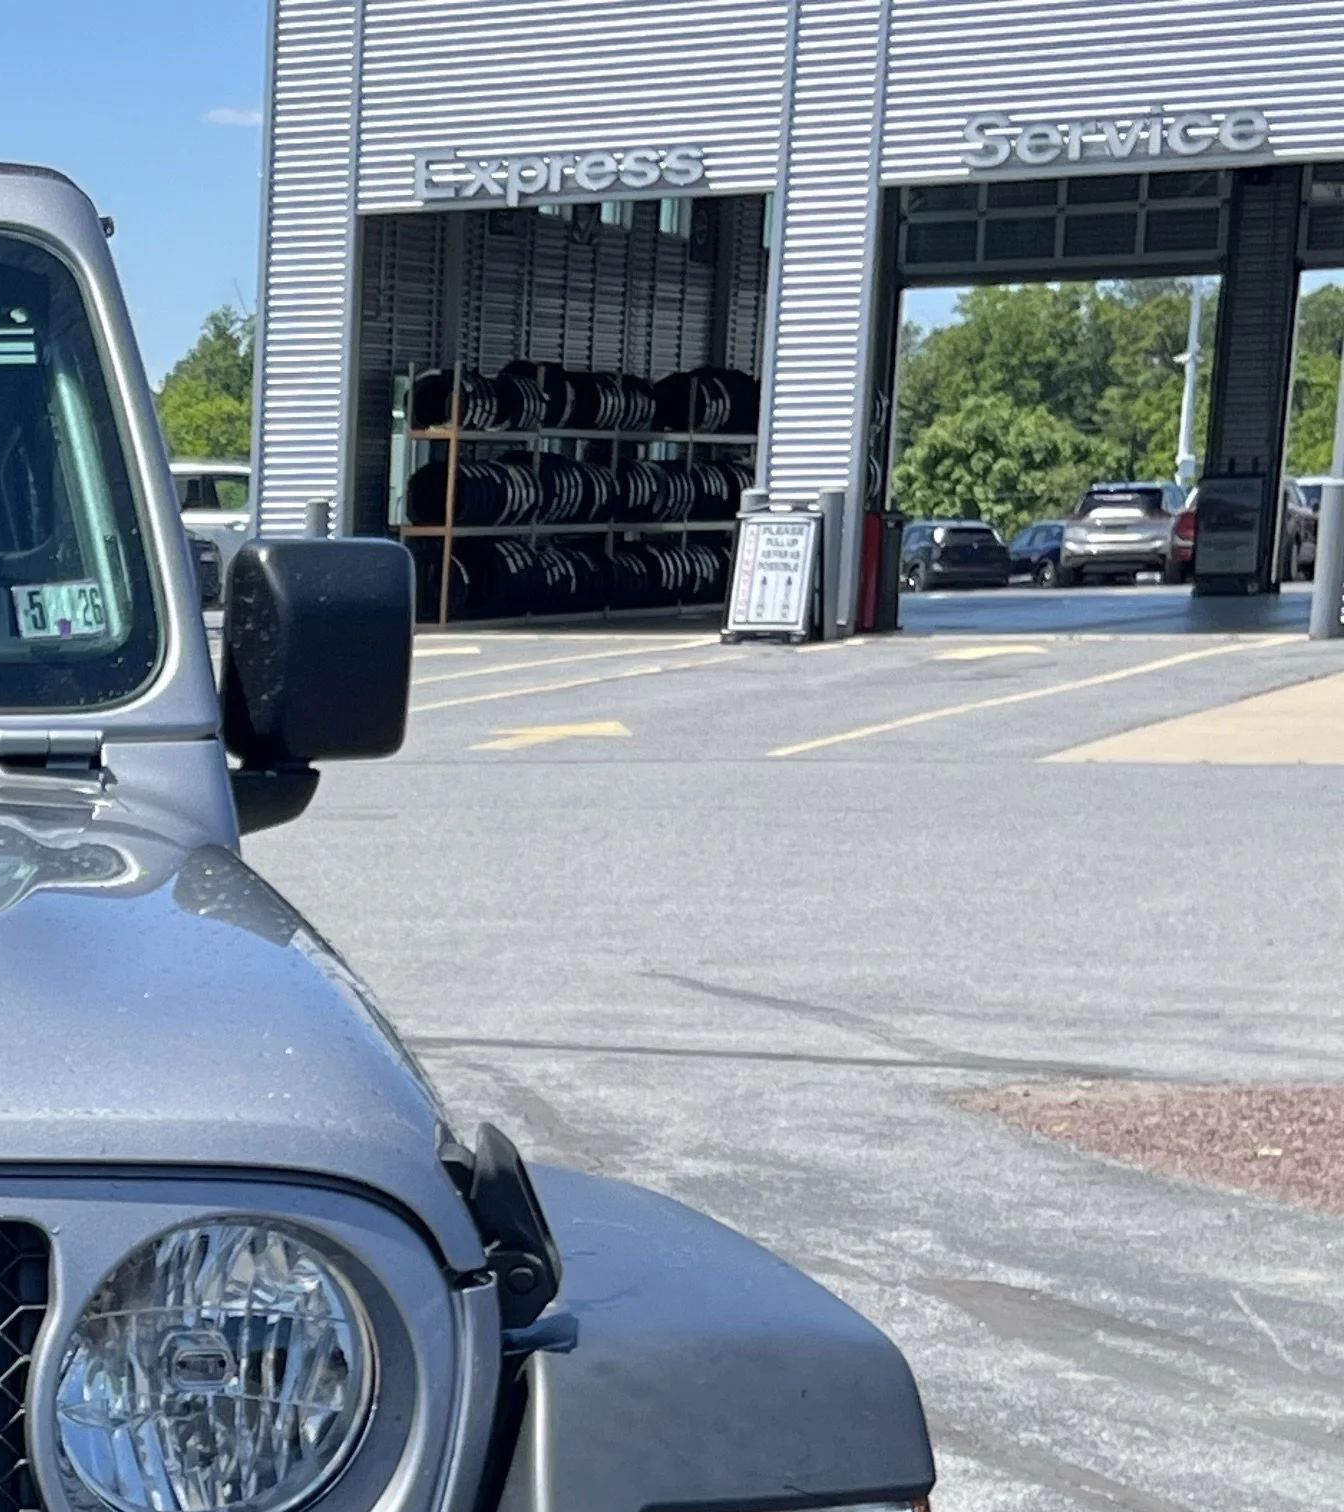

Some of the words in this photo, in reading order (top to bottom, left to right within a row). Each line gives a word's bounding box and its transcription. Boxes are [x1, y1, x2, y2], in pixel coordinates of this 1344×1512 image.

[962, 105, 1270, 168] Service
[413, 146, 706, 206] Express
[26, 590, 47, 630] 5
[78, 587, 104, 627] 26
